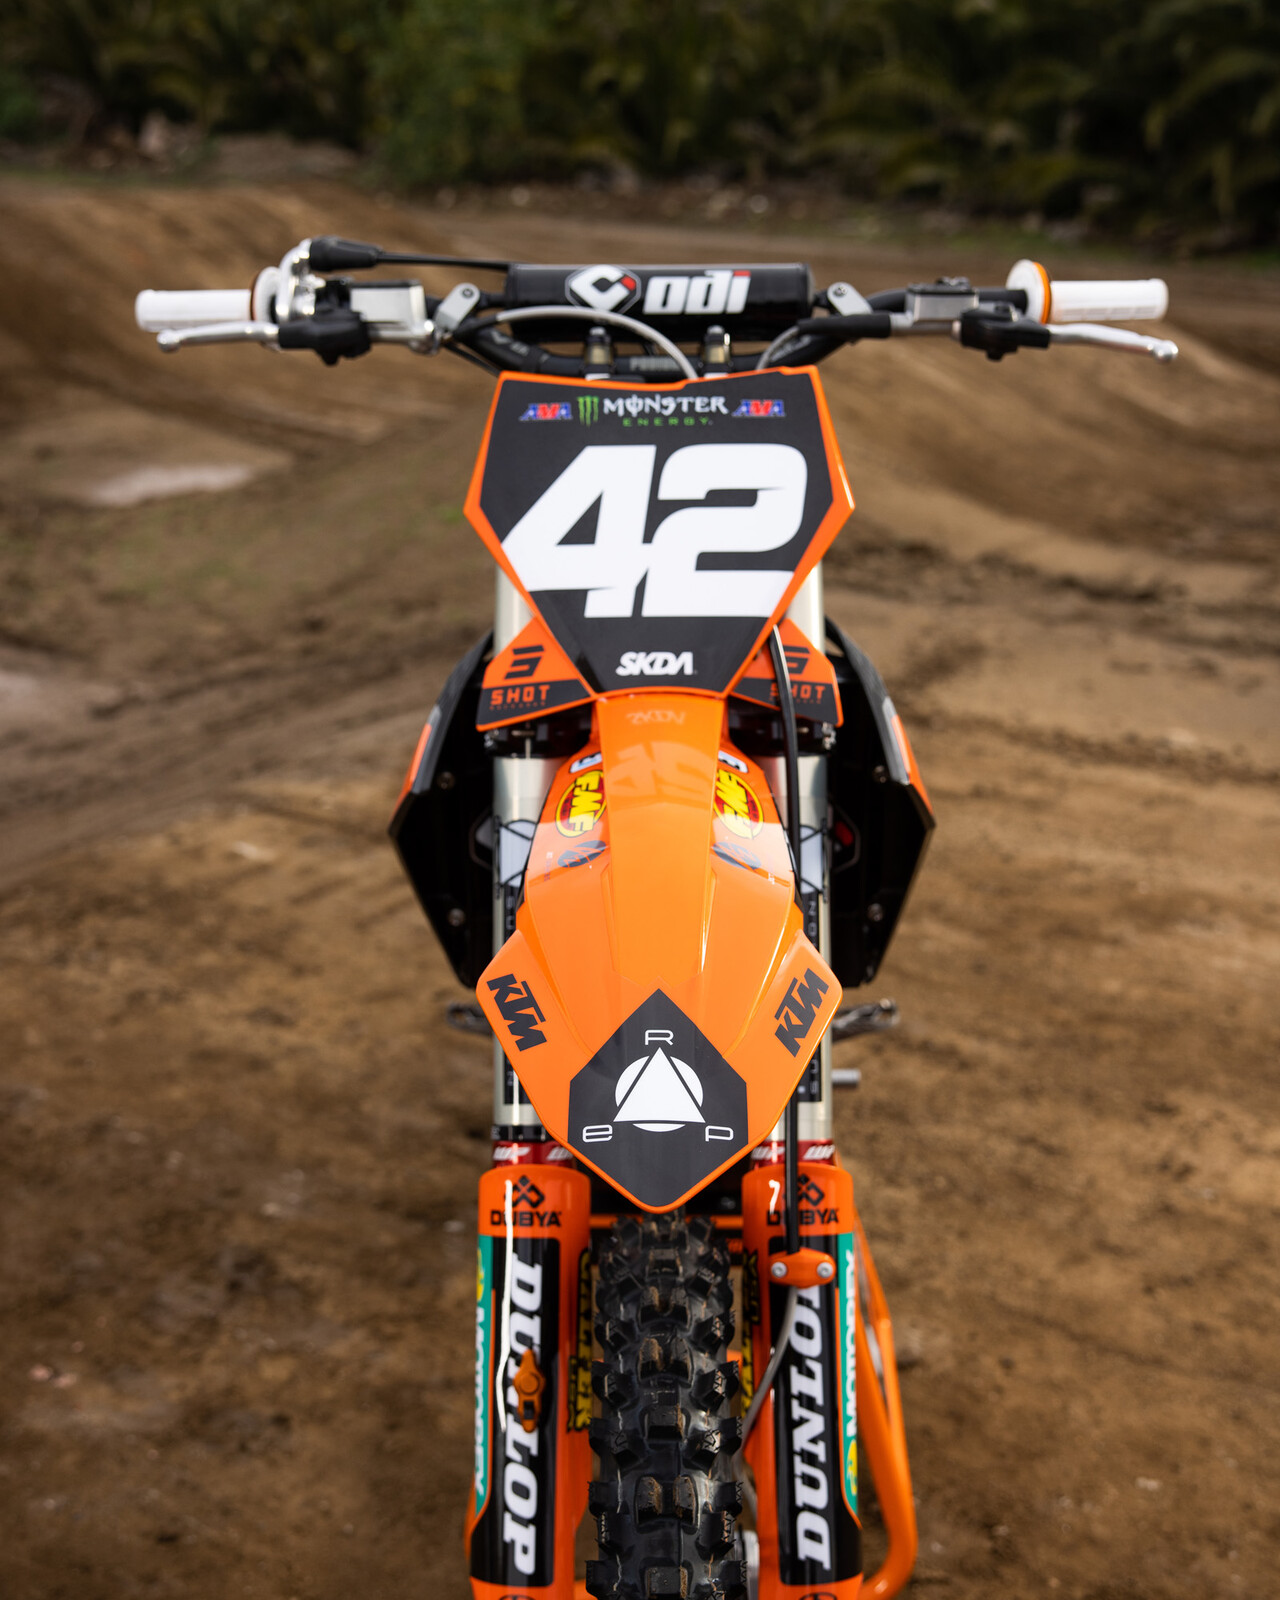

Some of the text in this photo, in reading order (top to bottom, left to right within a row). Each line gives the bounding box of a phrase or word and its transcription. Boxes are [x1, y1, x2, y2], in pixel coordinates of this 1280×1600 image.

[643, 270, 751, 315] odi
[519, 402, 573, 421] AMA
[603, 394, 729, 417] MONSTER
[732, 400, 786, 417] AMA
[502, 443, 807, 618] 42
[615, 651, 694, 676] SKDA
[490, 684, 550, 705] SHOT
[568, 773, 603, 831] FMF
[487, 974, 547, 1051] KTM
[774, 968, 829, 1058] KTM
[645, 1029, 674, 1045] R
[767, 1209, 838, 1226] DBYA
[503, 1251, 542, 1575] DULOP
